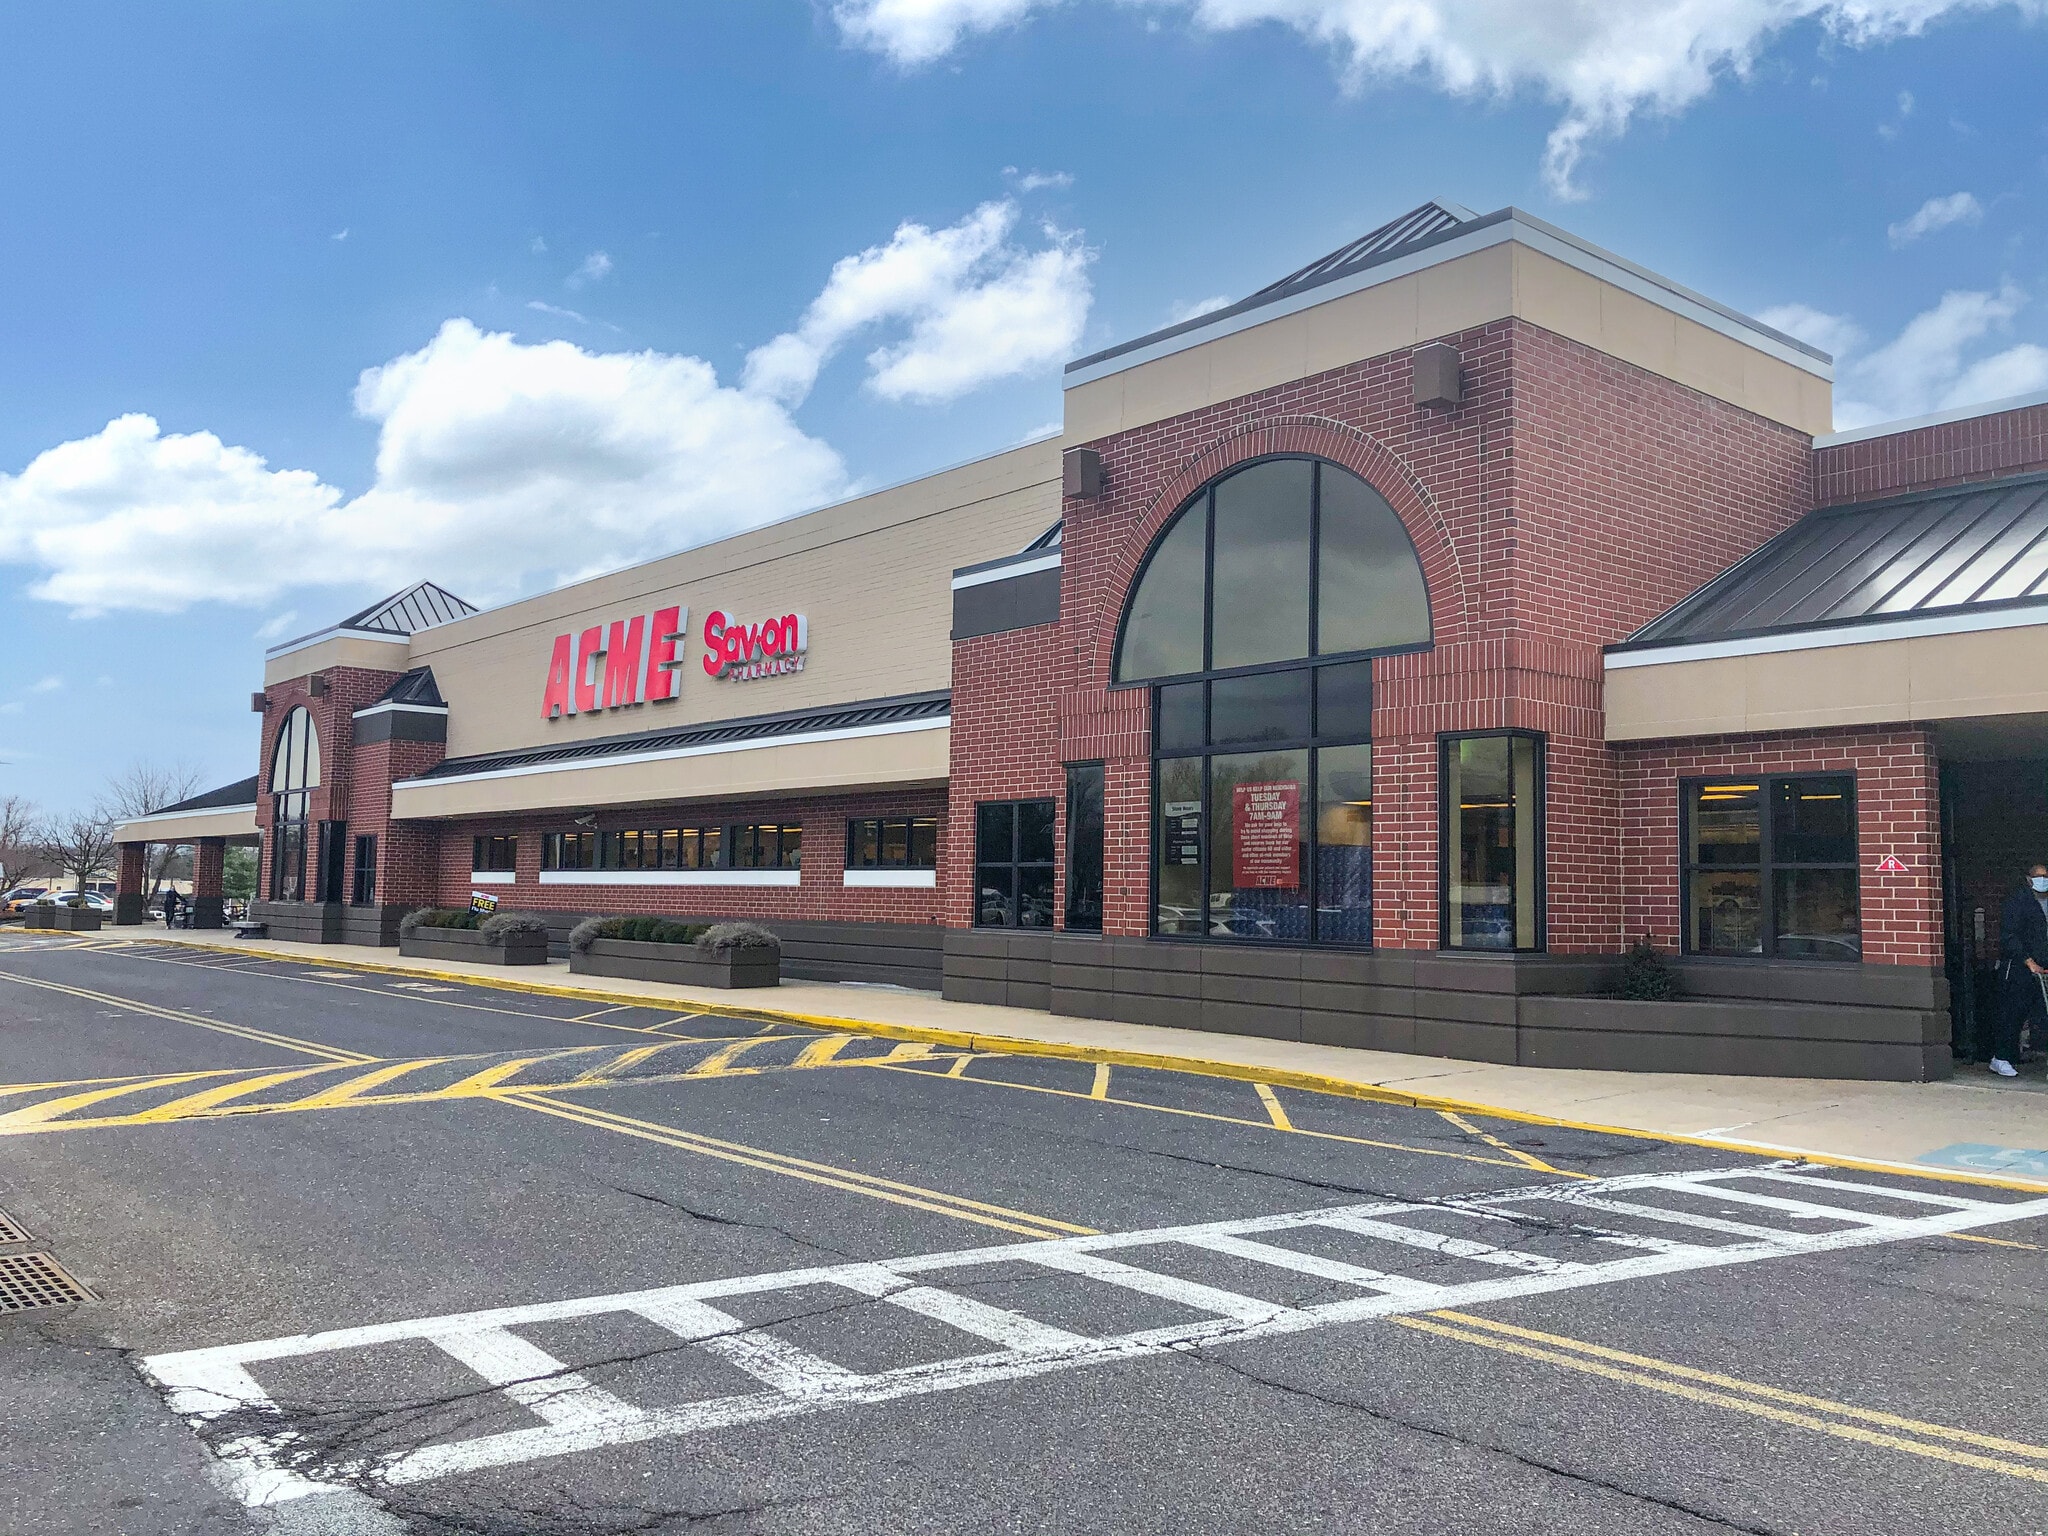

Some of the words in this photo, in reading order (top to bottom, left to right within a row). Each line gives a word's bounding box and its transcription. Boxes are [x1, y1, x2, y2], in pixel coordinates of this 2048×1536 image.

[541, 605, 684, 719] ACME
[728, 656, 802, 681] PHARMACY
[1251, 792, 1280, 802] TUESDAY
[1245, 803, 1251, 811] &
[1251, 801, 1286, 811] THURSDAY
[1249, 811, 1282, 820] 7AM-9AM
[1888, 860, 1895, 869] R
[472, 898, 495, 910] FREE
